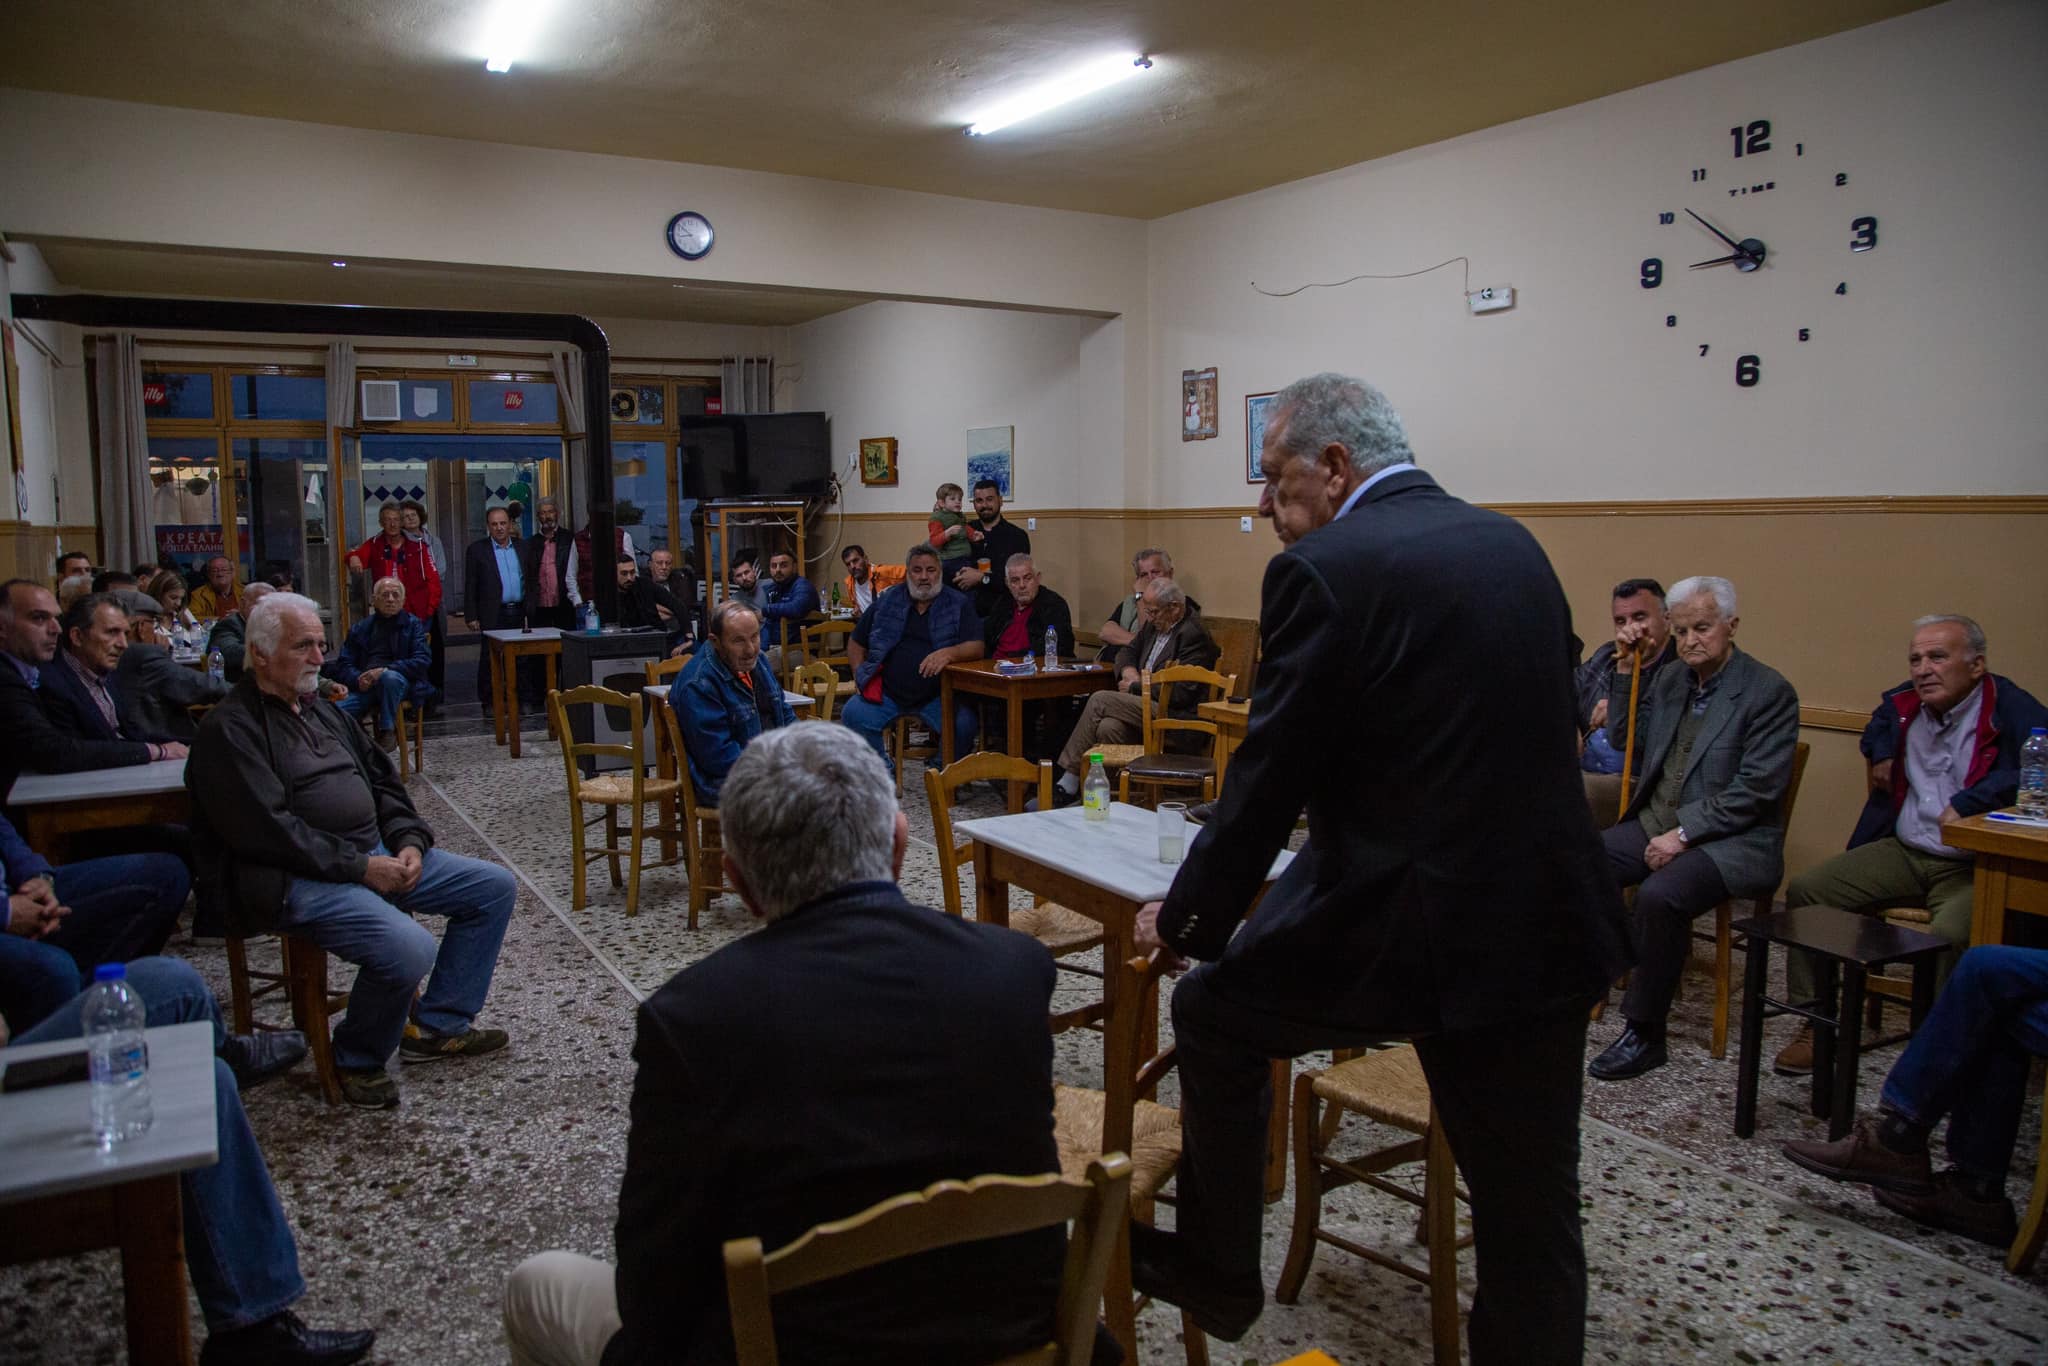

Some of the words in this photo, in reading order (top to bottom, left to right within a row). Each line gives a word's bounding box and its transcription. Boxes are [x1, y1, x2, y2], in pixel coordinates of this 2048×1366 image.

[1730, 120, 1771, 158] 12
[1796, 143, 1803, 156] 1
[1692, 169, 1706, 182] 11
[1835, 173, 1847, 186] 2
[1728, 182, 1776, 197] TIME
[1659, 212, 1675, 225] 10
[1850, 216, 1878, 252] 3
[1640, 258, 1663, 289] 9
[1835, 282, 1847, 295] 4
[1666, 315, 1677, 327] 8
[1799, 328, 1809, 341] 5
[1699, 344, 1709, 357] 7
[1735, 354, 1760, 387] 6
[144, 387, 164, 402] illy
[506, 393, 522, 409] illy
